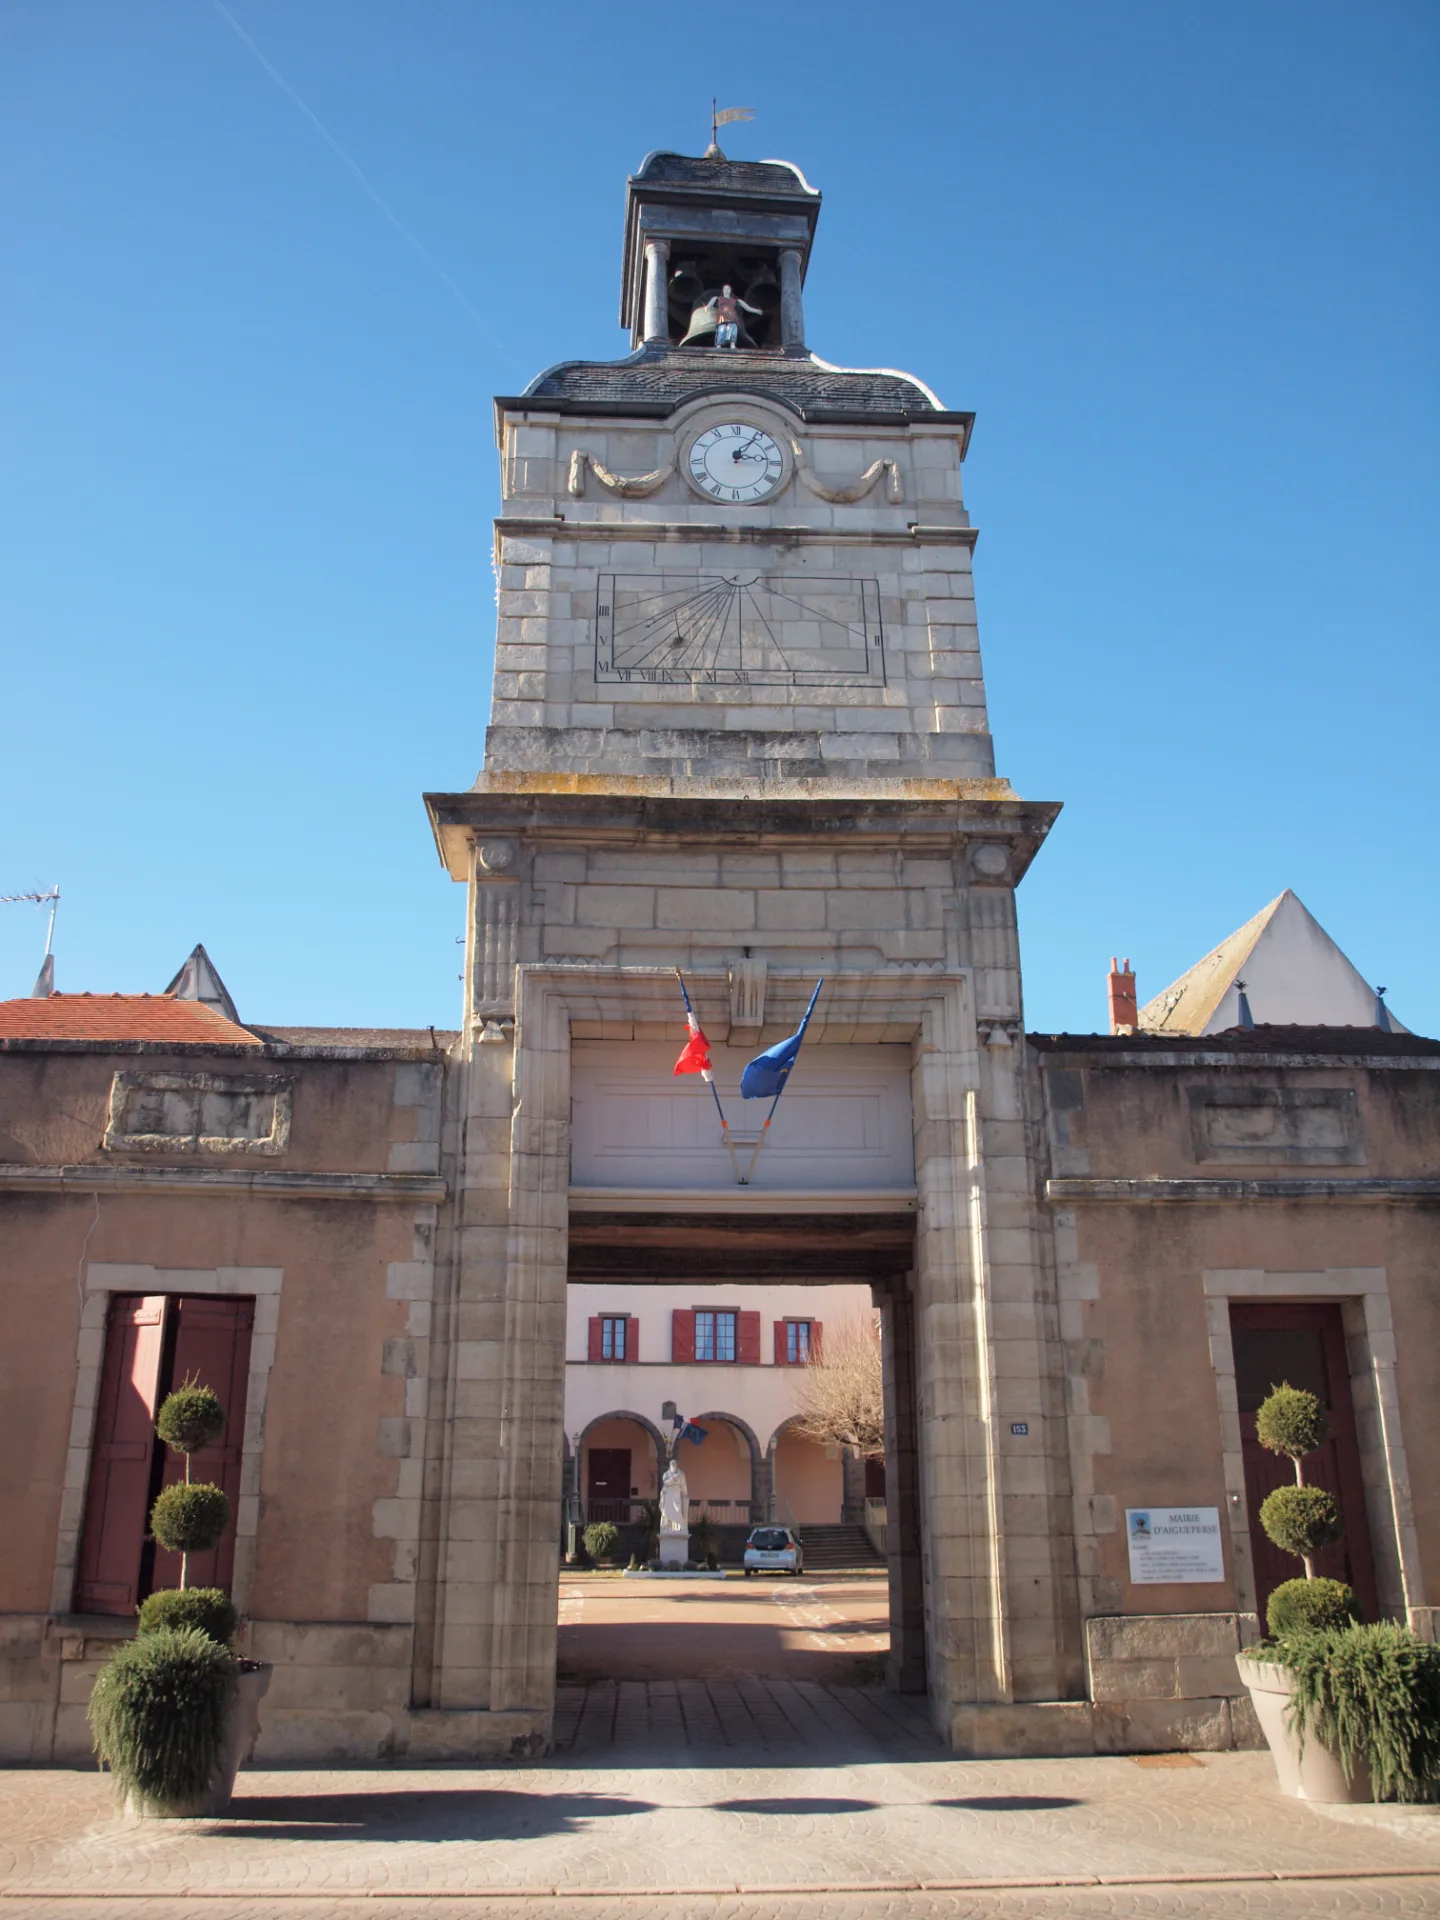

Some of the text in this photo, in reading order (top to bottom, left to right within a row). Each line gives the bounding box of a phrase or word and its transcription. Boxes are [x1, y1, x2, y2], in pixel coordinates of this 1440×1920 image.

[731, 426, 741, 435] XII
[732, 490, 740, 499] VI
[753, 487, 761, 496] V
[599, 605, 609, 616] IIII
[599, 636, 608, 645] V
[874, 635, 880, 646] II
[598, 661, 609, 672] VI
[617, 670, 631, 681] VII
[640, 670, 656, 681] VIII
[662, 670, 674, 681] IX
[684, 671, 694, 682] X
[706, 671, 716, 682] XI
[734, 671, 749, 685] XII
[1013, 1425, 1026, 1433] 153
[1169, 1514, 1200, 1522] MAIRIE
[1153, 1526, 1217, 1535] D'AIGUEPERSE
